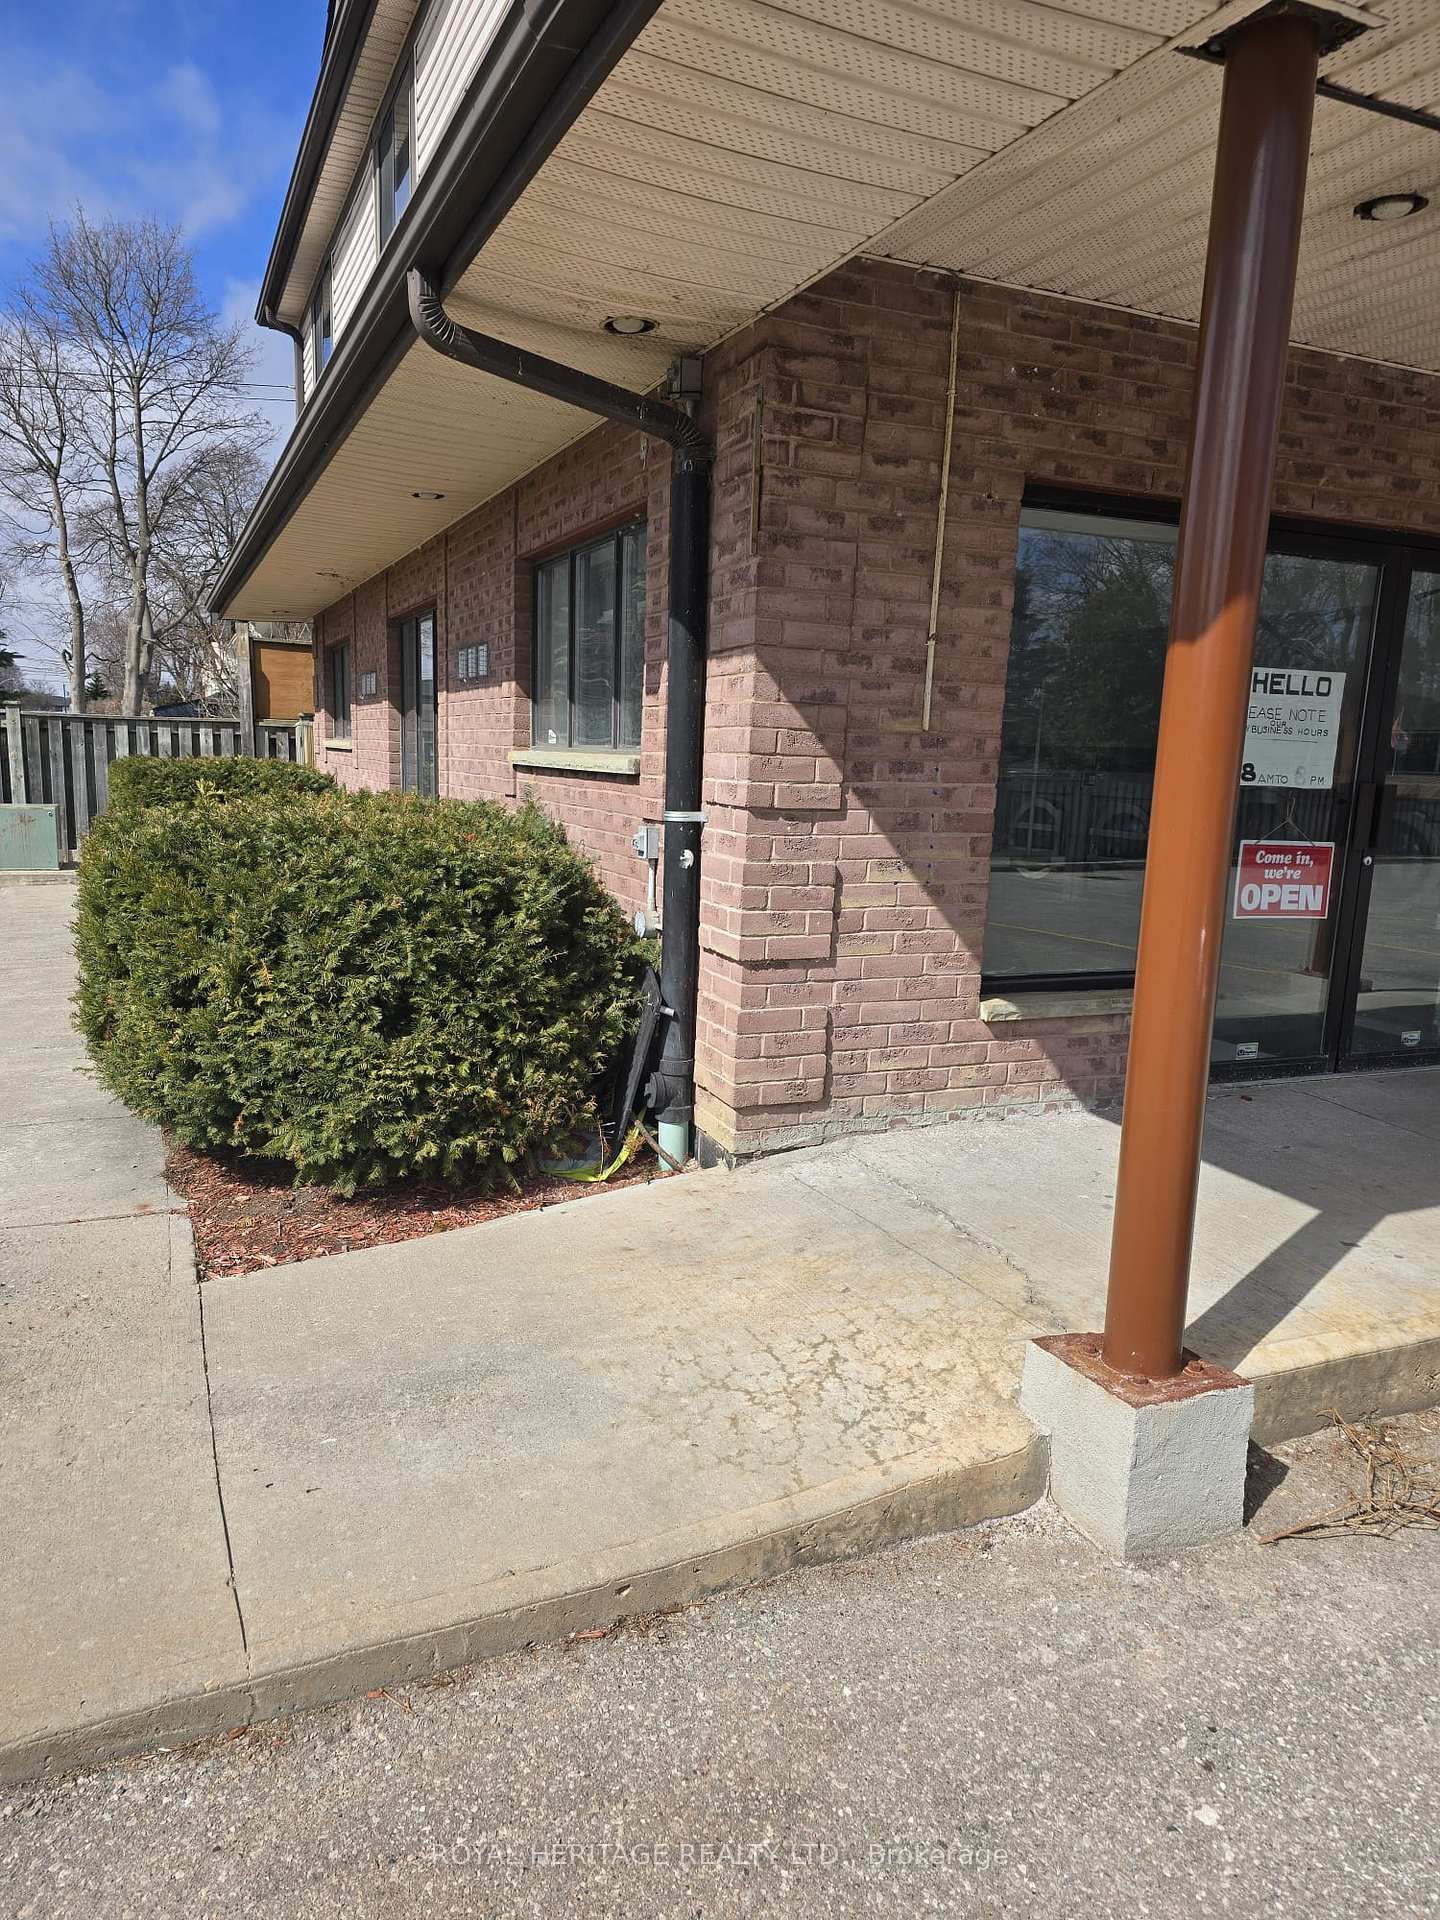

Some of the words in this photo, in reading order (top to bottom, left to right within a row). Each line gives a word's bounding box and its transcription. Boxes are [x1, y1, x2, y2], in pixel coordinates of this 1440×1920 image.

[1251, 672, 1332, 697] HELLO
[1248, 706, 1283, 721] EASE
[1288, 708, 1327, 723] NOTE
[1251, 725, 1293, 735] BUSINESS
[1297, 728, 1329, 737] HOURS
[1241, 762, 1256, 782] 8
[1255, 850, 1292, 865] Come
[1296, 851, 1313, 867] in,
[1264, 867, 1301, 879] we're
[1240, 883, 1324, 911] OPEN
